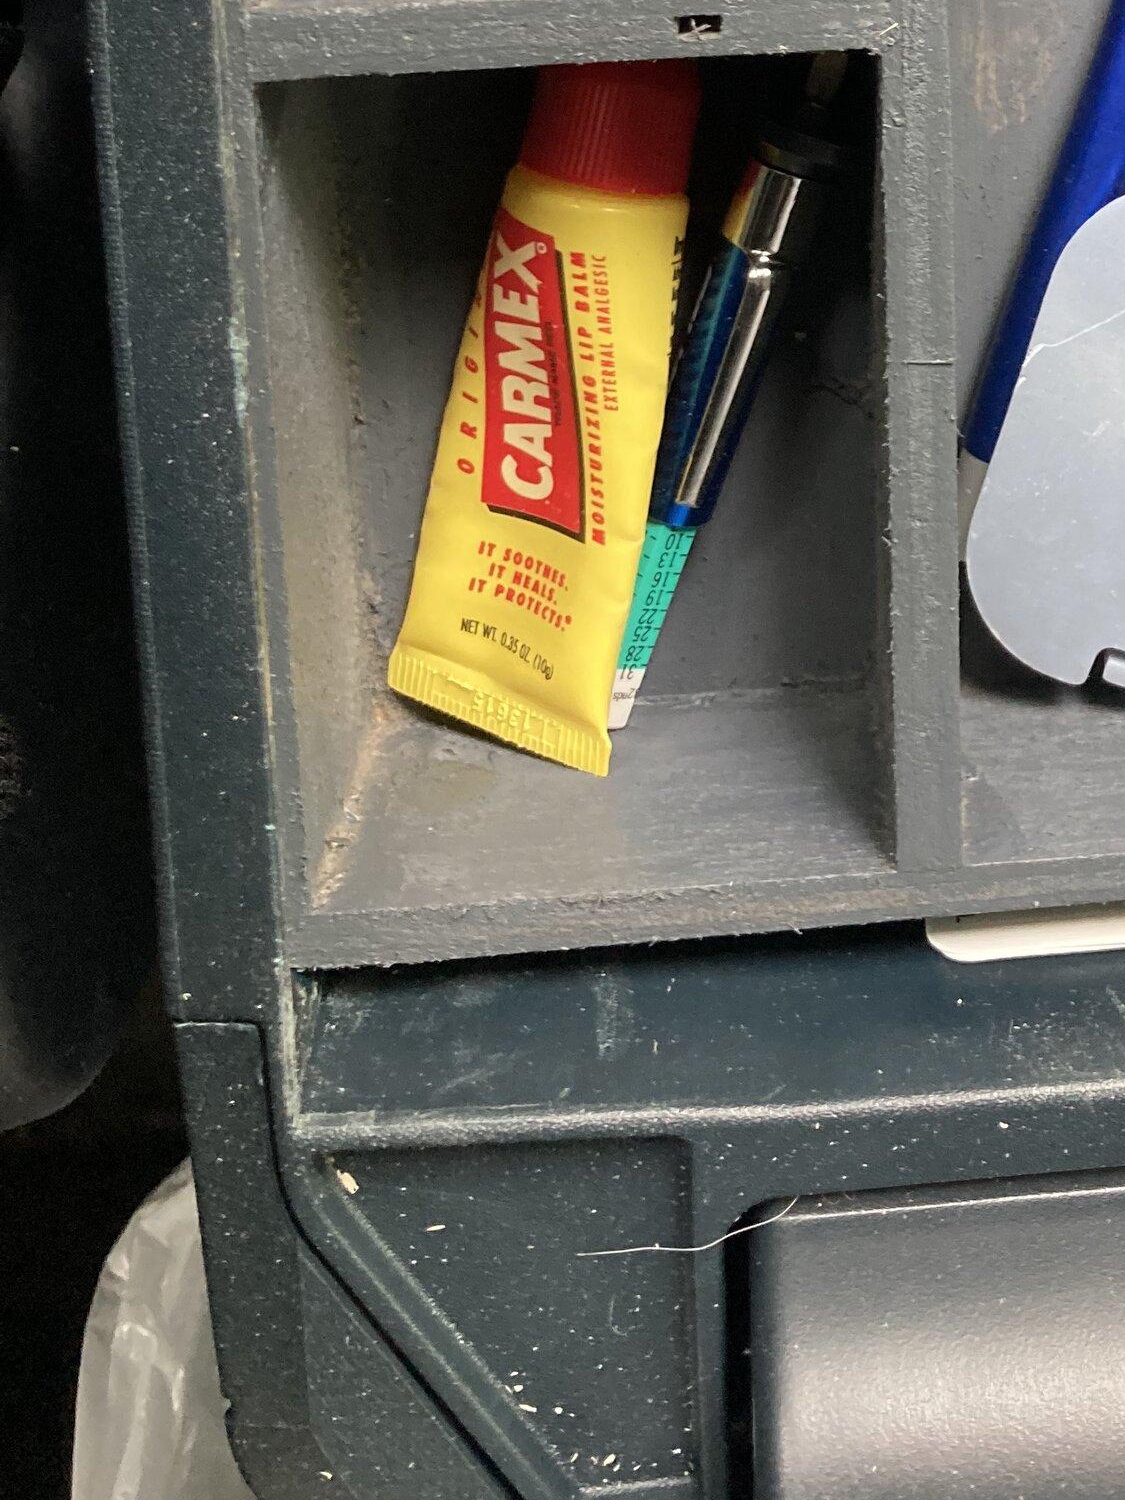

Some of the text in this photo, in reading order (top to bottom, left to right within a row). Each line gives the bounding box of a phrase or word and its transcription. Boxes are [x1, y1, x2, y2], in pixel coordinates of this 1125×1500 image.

[592, 254, 619, 412] EXTERNAL ANALGESIC
[492, 228, 554, 501] CARMEX
[570, 252, 606, 545] MOISTURIZING LIP BALM
[665, 533, 683, 550] 10
[478, 540, 568, 591] IT SOOTHES.
[658, 552, 676, 568] 13
[468, 577, 487, 593] IT
[488, 562, 557, 605] IT HEALS.
[653, 571, 670, 587] 16
[645, 590, 663, 607] 19
[638, 609, 656, 624] 22
[632, 626, 650, 642] 25
[461, 618, 480, 635] NET
[500, 632, 518, 654] 0.35
[533, 653, 554, 680] (10g)
[625, 646, 644, 661] 28
[619, 664, 634, 680] 31
